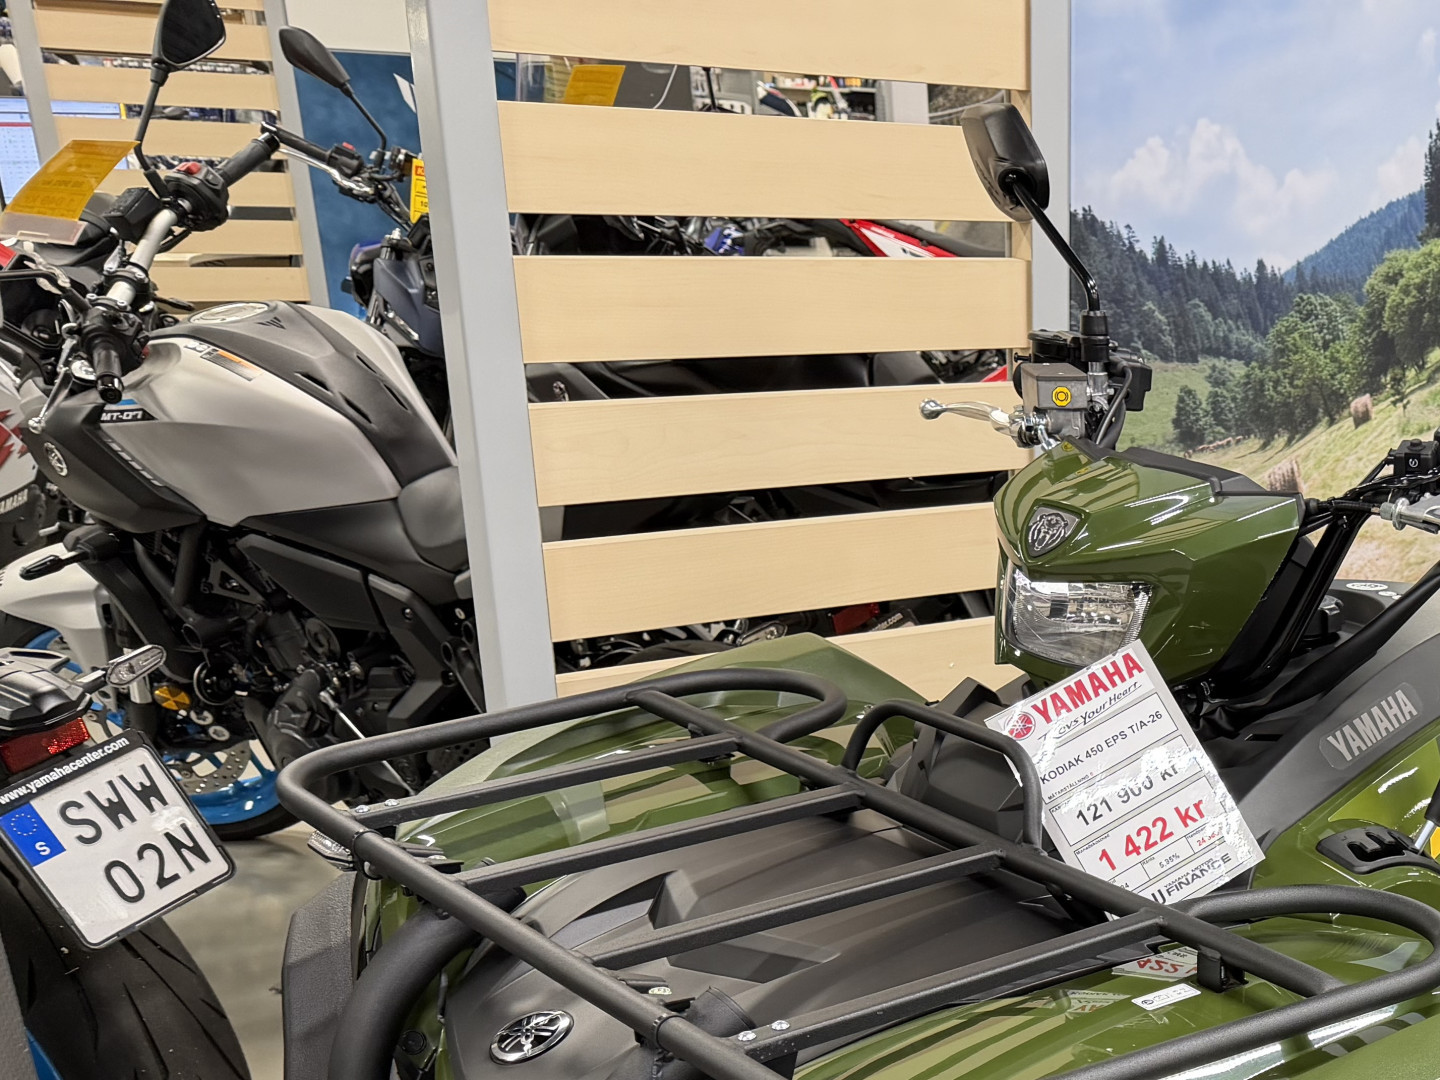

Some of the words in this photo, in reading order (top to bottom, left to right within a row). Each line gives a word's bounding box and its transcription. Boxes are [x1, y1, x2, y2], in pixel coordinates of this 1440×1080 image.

[101, 410, 143, 421] MT-07
[1031, 652, 1144, 724] YAMAHA
[1080, 701, 1109, 725] Your
[1108, 682, 1143, 706] Heart
[1040, 755, 1084, 784] KODIAK
[1085, 743, 1104, 760] 450
[1104, 730, 1128, 749] EPS
[1129, 710, 1163, 735] T/A-26
[1327, 689, 1418, 762] YAMAHA
[0, 736, 130, 804] www.yamahacenter.com
[59, 763, 169, 845] SWW
[1076, 796, 1113, 826] 121
[1098, 848, 1117, 871] 1
[1124, 816, 1174, 859] 422
[1173, 799, 1207, 828] kr
[34, 841, 51, 856] S
[104, 822, 212, 903] 02N
[1166, 852, 1232, 897] FINANCE
